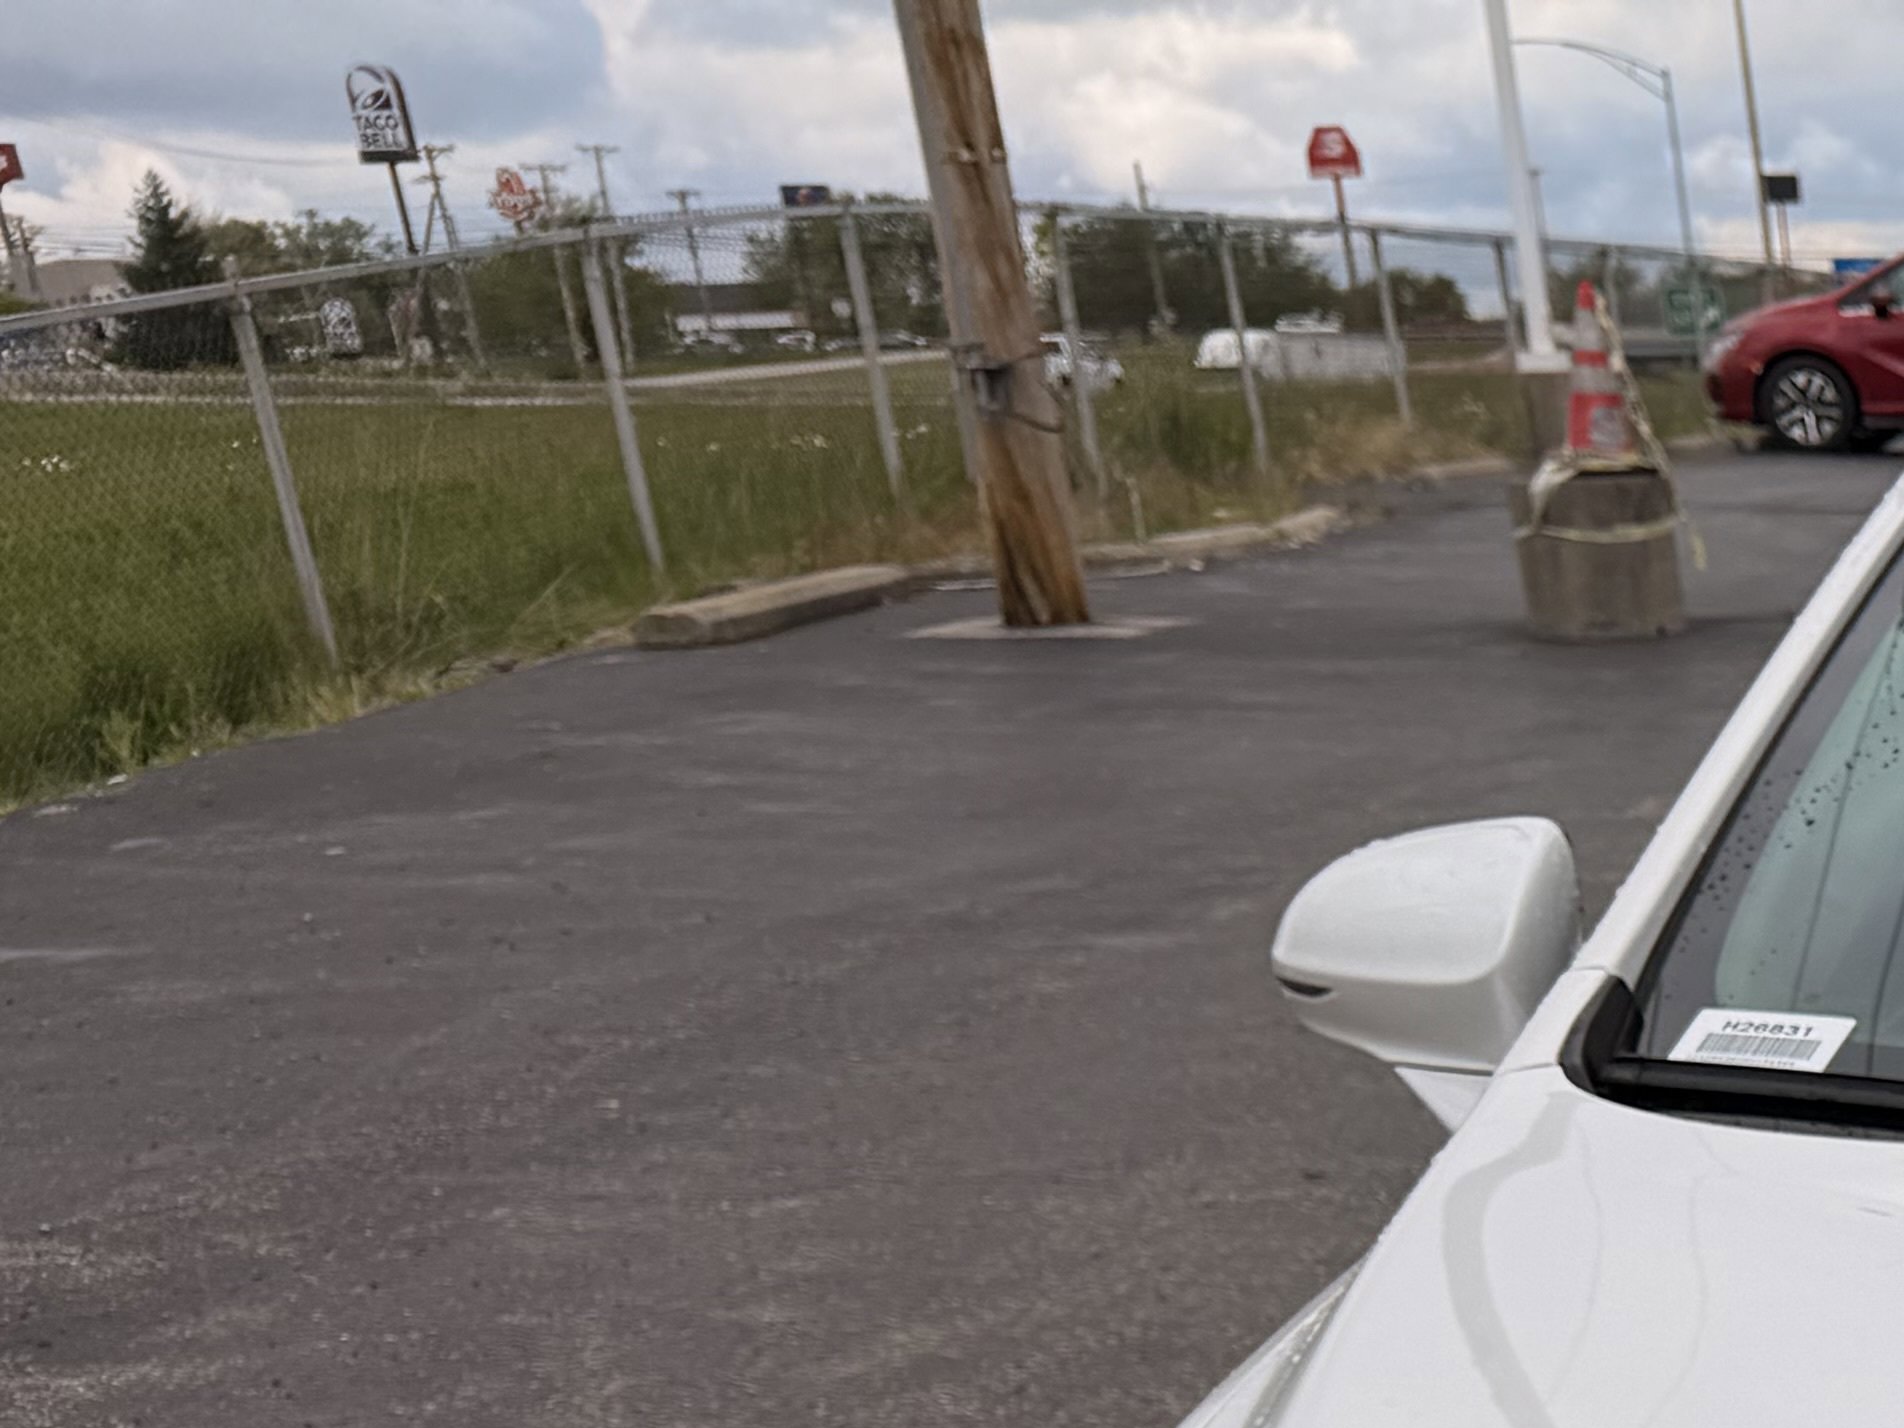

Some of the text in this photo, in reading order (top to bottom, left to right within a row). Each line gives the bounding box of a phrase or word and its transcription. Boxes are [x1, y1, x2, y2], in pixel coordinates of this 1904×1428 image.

[352, 115, 399, 131] TACO
[361, 132, 404, 148] BELL
[1721, 1020, 1814, 1037] H26831
